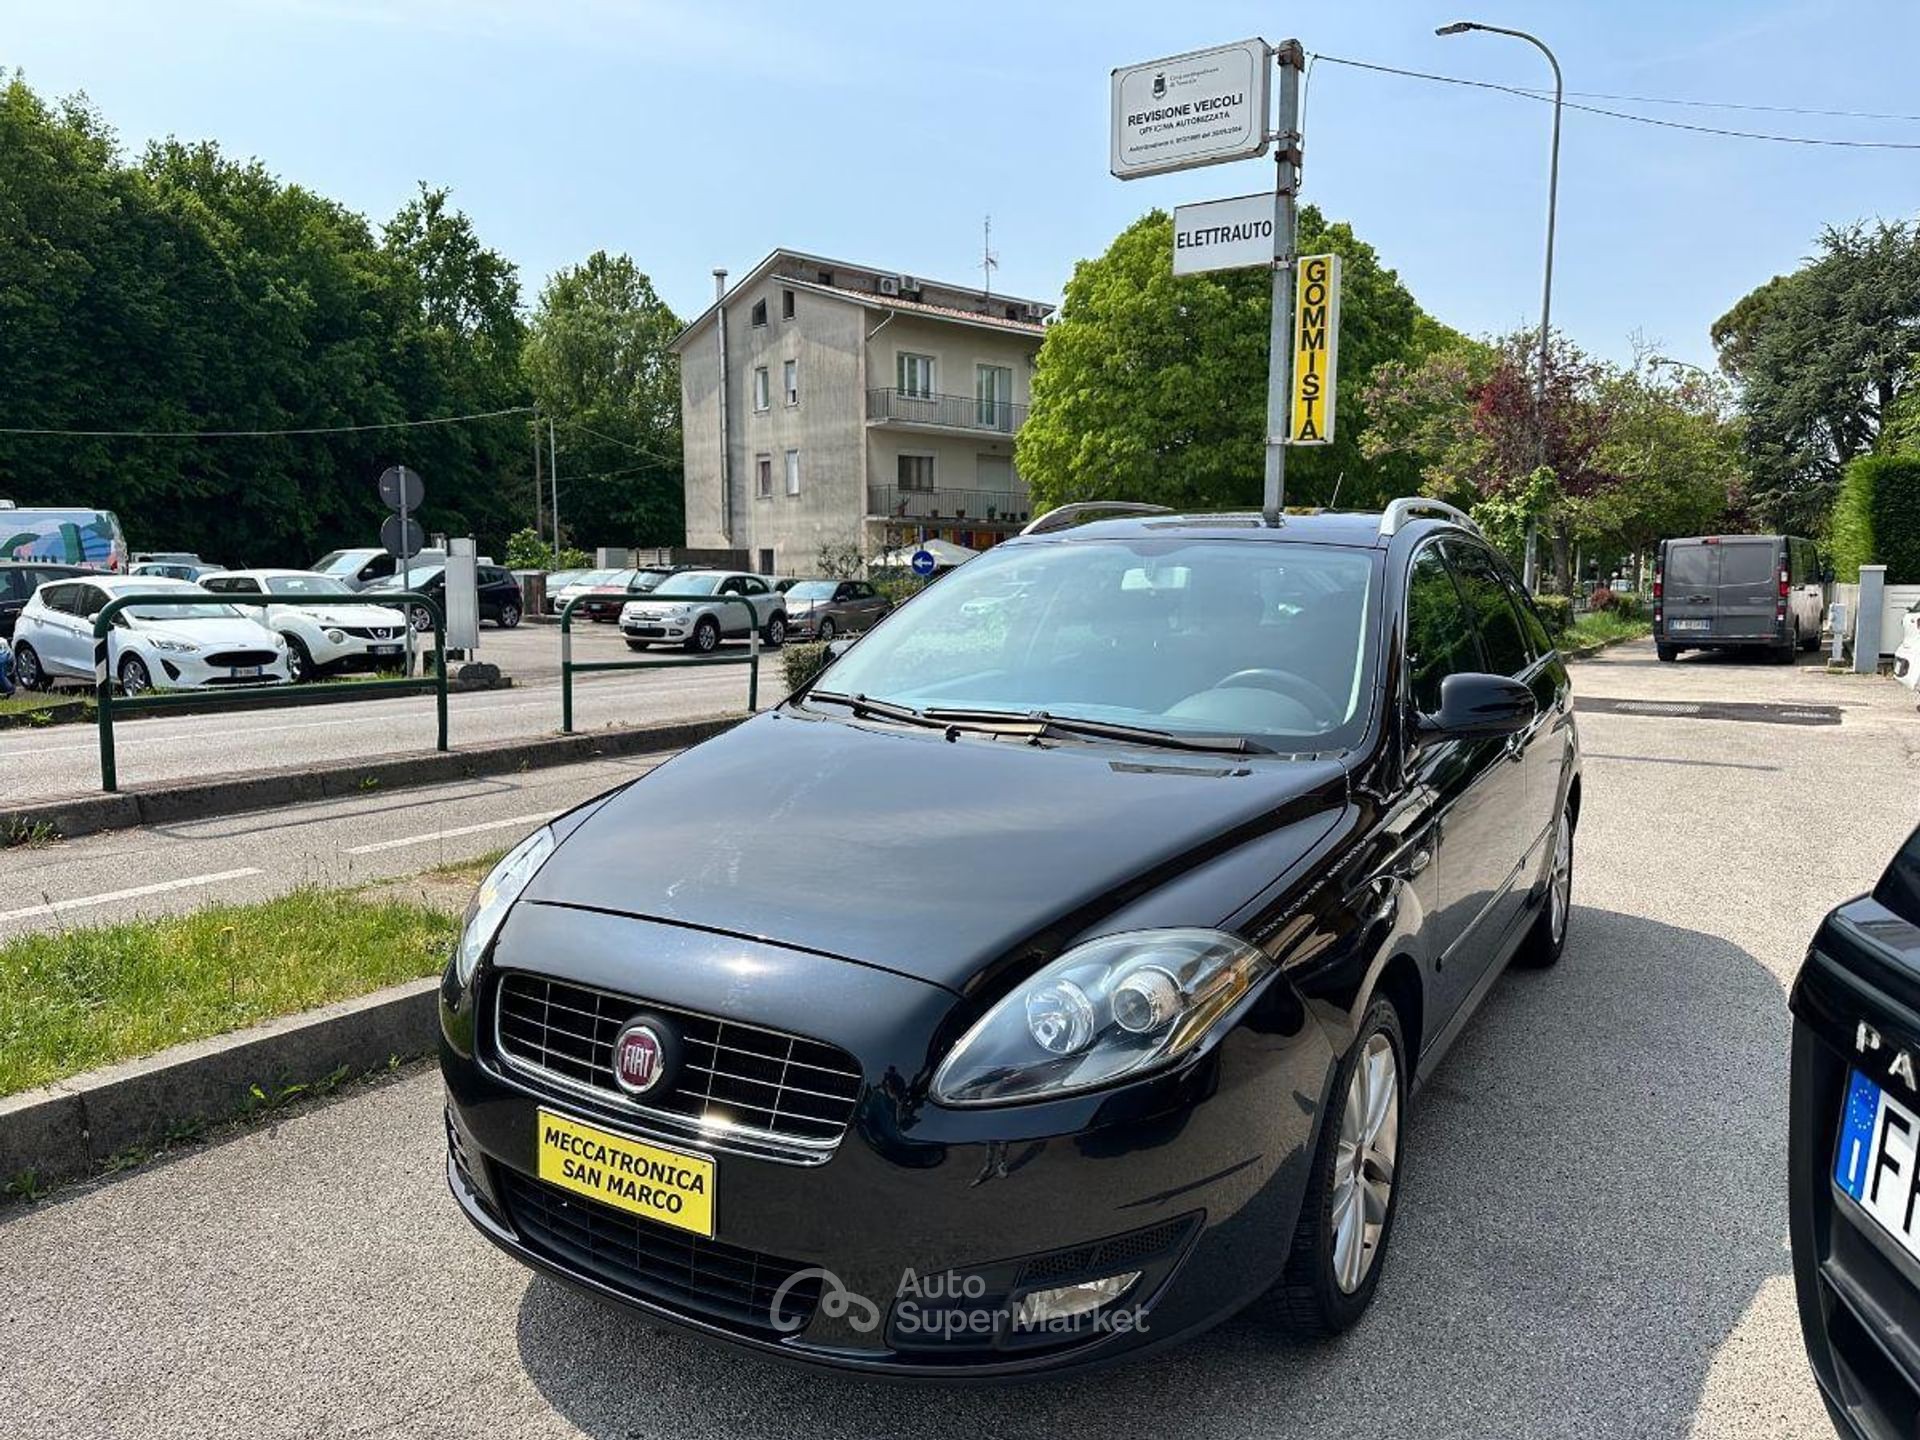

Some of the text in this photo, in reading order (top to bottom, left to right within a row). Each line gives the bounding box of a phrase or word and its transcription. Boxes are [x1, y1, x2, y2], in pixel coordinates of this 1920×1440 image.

[1128, 93, 1243, 127] REVISIONE VEICOLI
[1139, 111, 1230, 136] OFFICINA AUTORIZZATA
[1177, 220, 1272, 249] ELETTRAUTO
[1300, 260, 1327, 442] GOMMISTA
[623, 1044, 653, 1079] FIAT
[544, 1126, 705, 1195] MECCATRONICA
[562, 1159, 683, 1214] SAN MARCO
